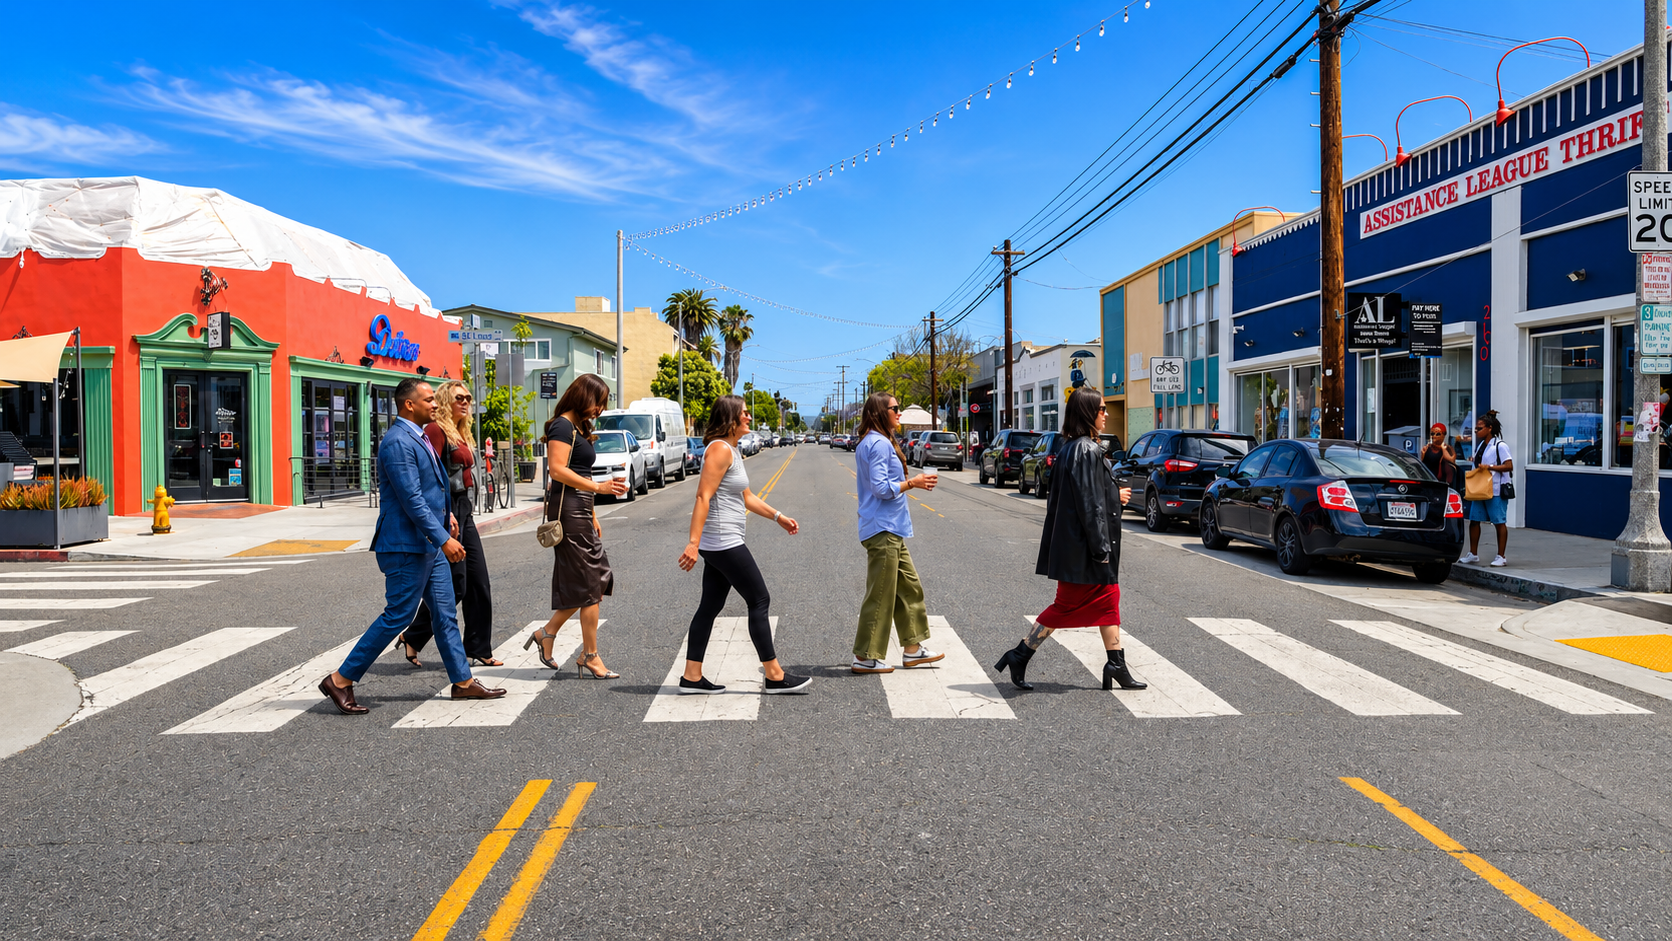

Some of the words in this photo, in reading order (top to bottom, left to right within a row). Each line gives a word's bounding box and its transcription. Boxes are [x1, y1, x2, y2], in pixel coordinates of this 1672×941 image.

[1363, 181, 1459, 234] ASSISTANCE
[1465, 146, 1549, 198] LEAGUE
[1560, 110, 1644, 164] THRIF
[1634, 181, 1672, 193] SPEE
[1635, 213, 1672, 242] 20
[1354, 296, 1395, 324] AL
